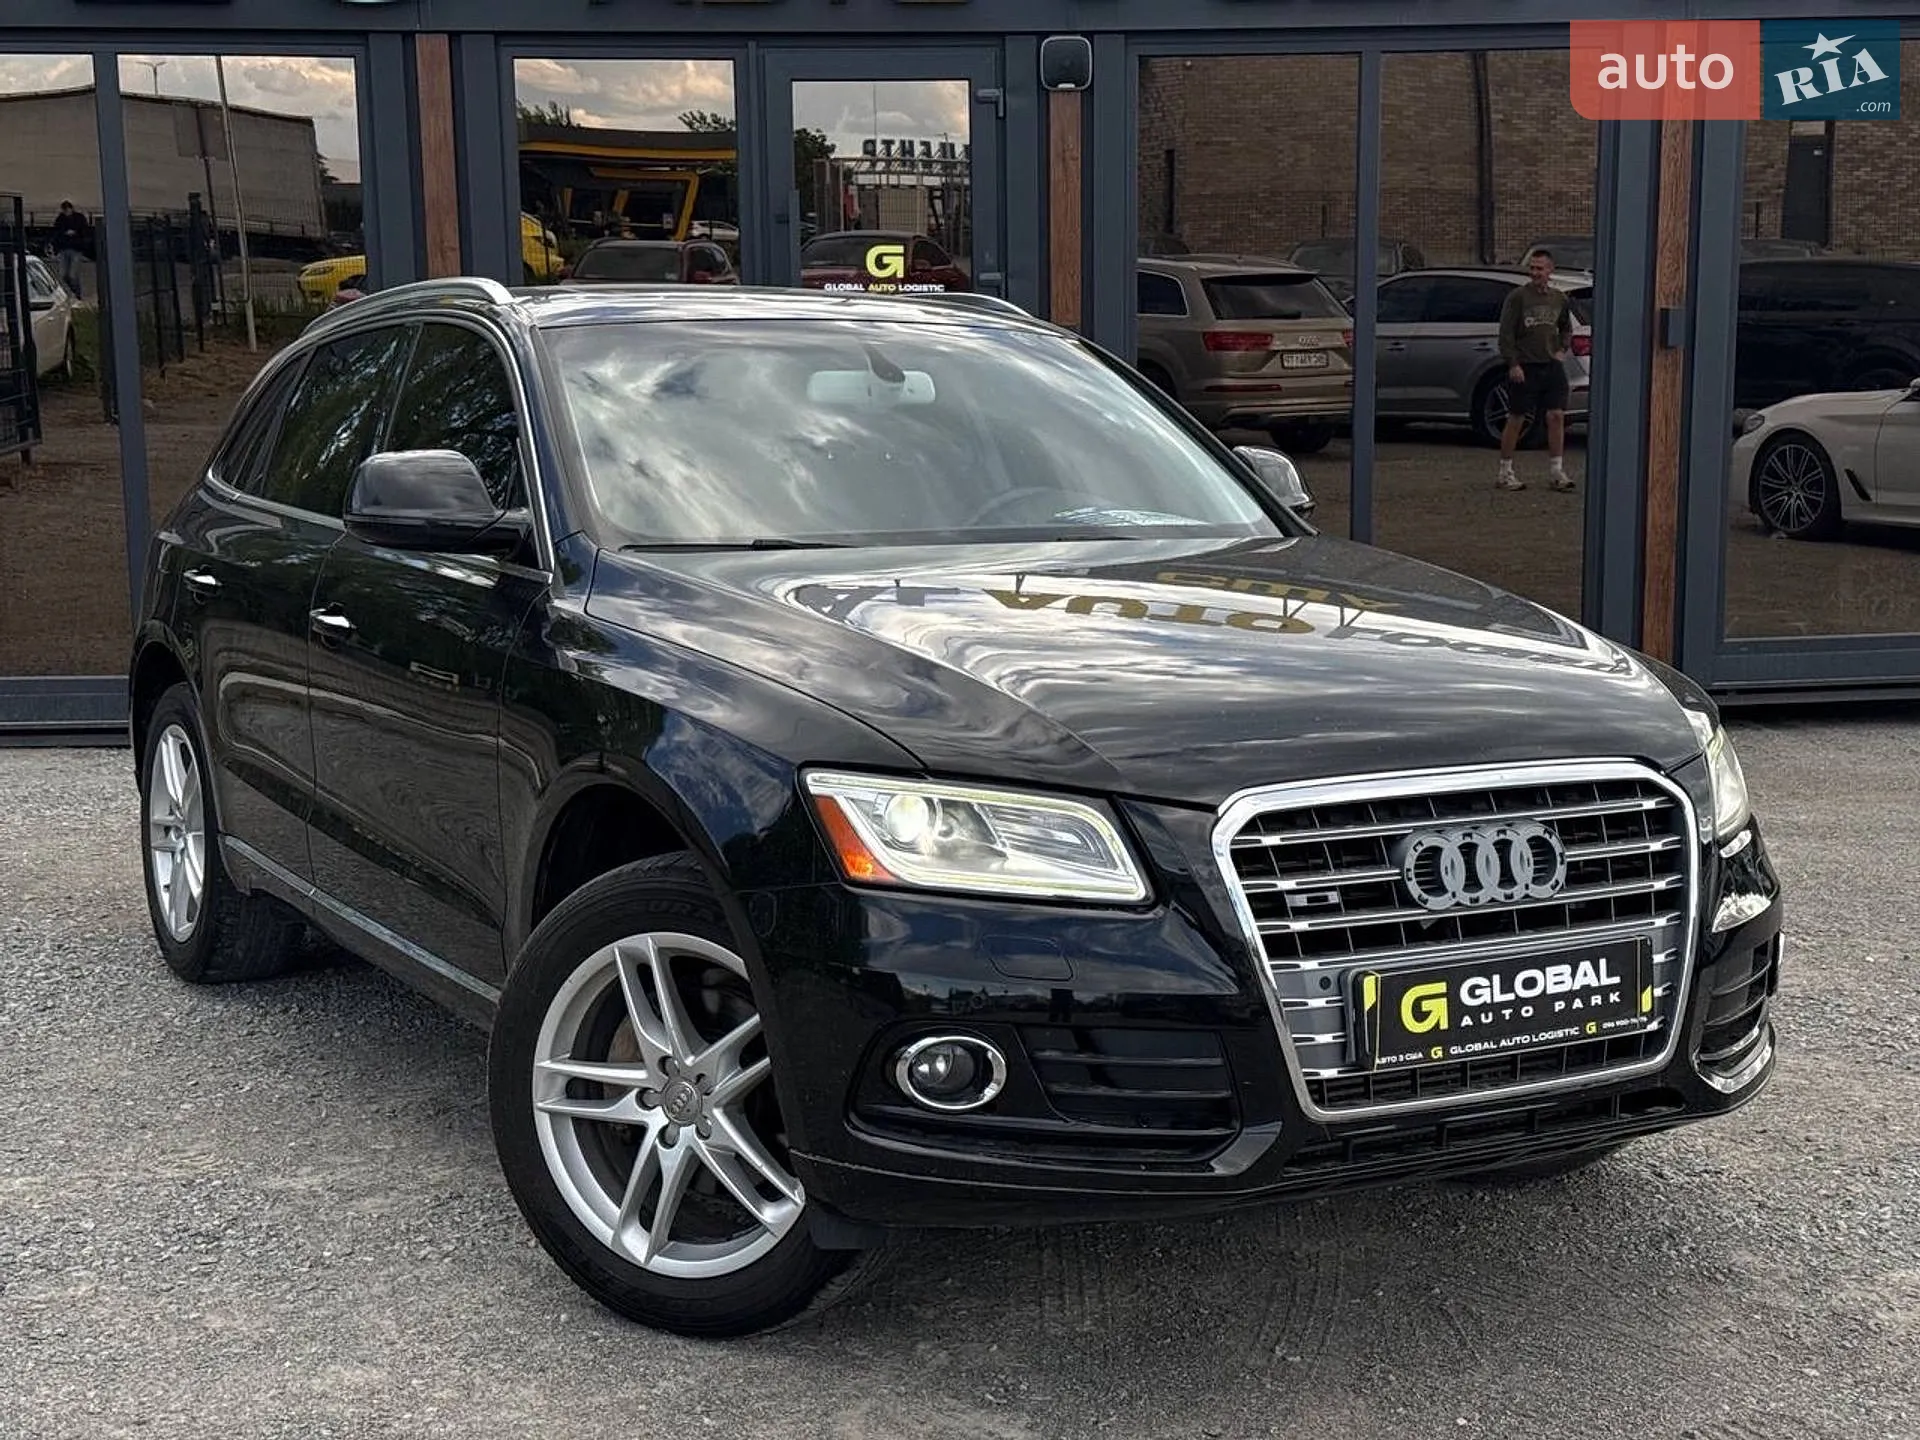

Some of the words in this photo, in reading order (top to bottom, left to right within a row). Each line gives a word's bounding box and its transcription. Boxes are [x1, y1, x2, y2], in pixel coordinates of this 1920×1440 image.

[824, 283, 865, 292] GLOBAL
[868, 284, 896, 292] AUTO
[899, 284, 945, 292] LOGISTIC
[1460, 958, 1621, 1006] GLOBAL
[1460, 1006, 1534, 1027] AUTO
[1554, 992, 1621, 1012] PARK
[1450, 1041, 1497, 1055] GLOBAL
[1499, 1035, 1530, 1047] AUTO
[1532, 1027, 1580, 1042] LOGISTIC
